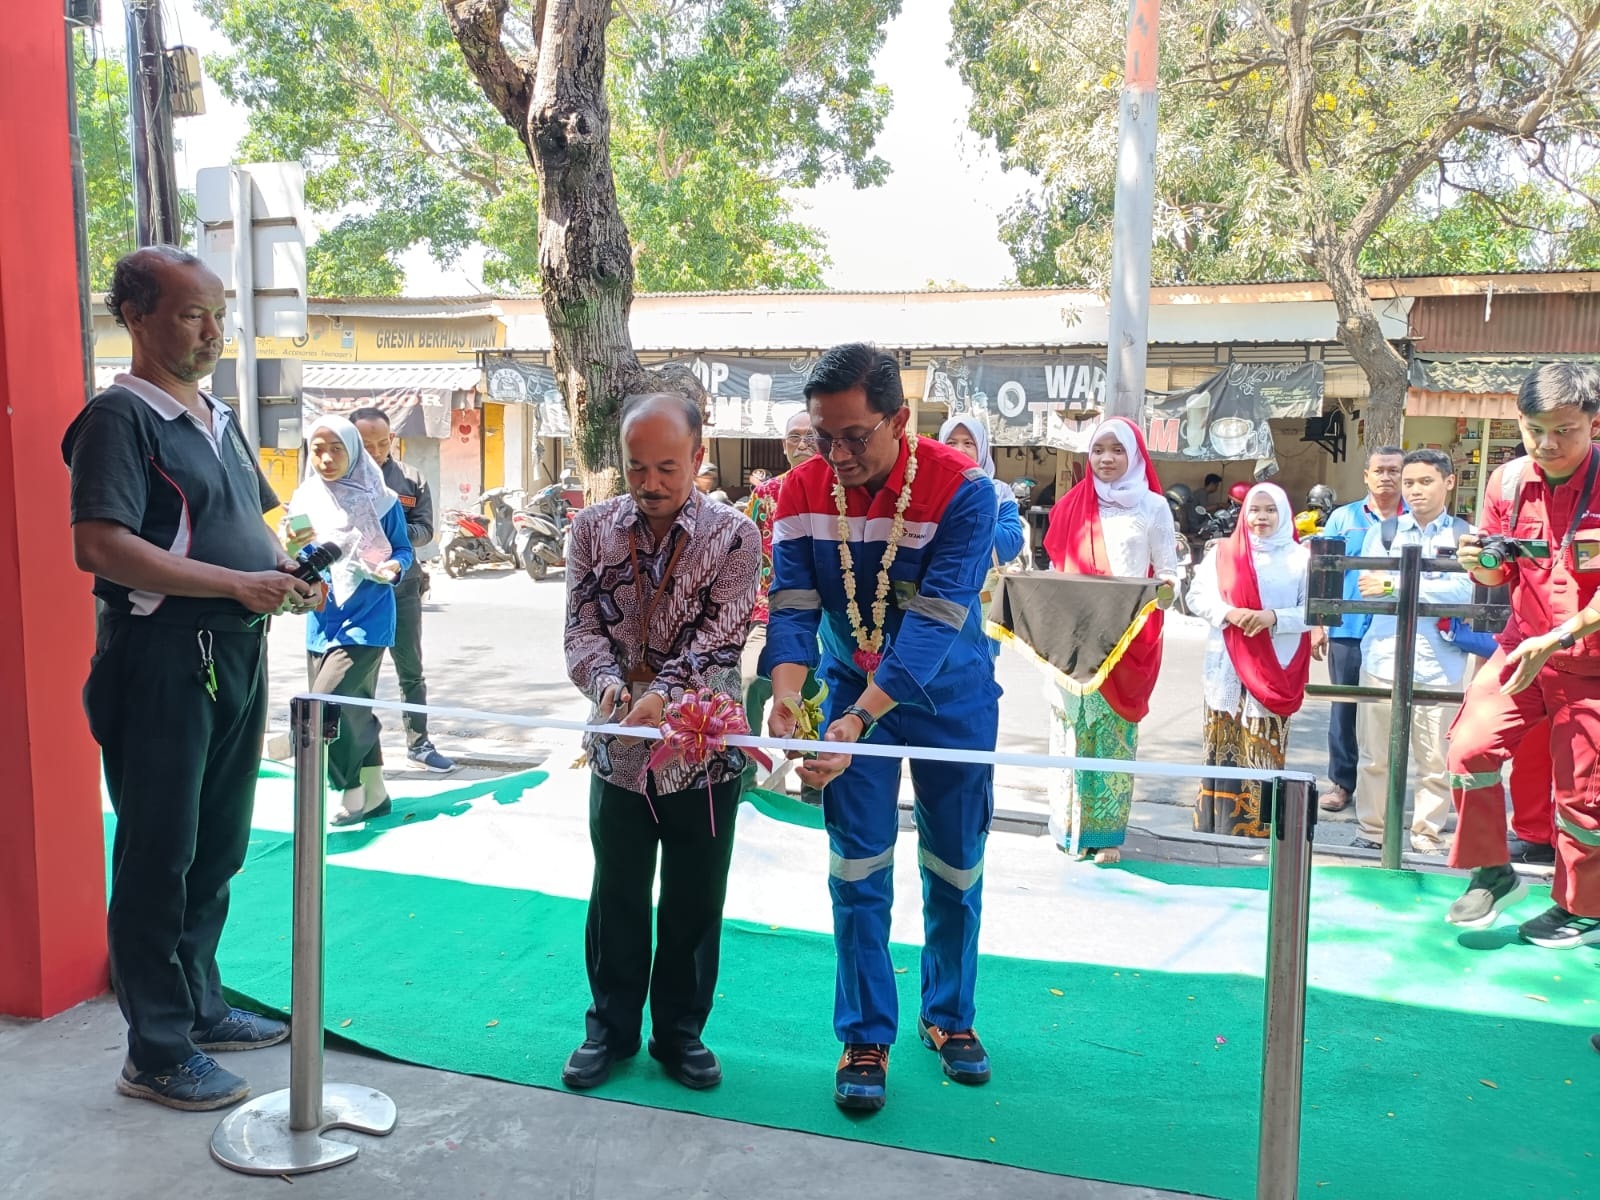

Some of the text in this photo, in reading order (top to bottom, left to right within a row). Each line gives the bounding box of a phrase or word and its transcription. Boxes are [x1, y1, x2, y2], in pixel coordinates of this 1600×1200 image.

[376, 327, 415, 349] GRESIK
[418, 327, 466, 348] BERHIAS
[321, 394, 444, 411] MOTOR
